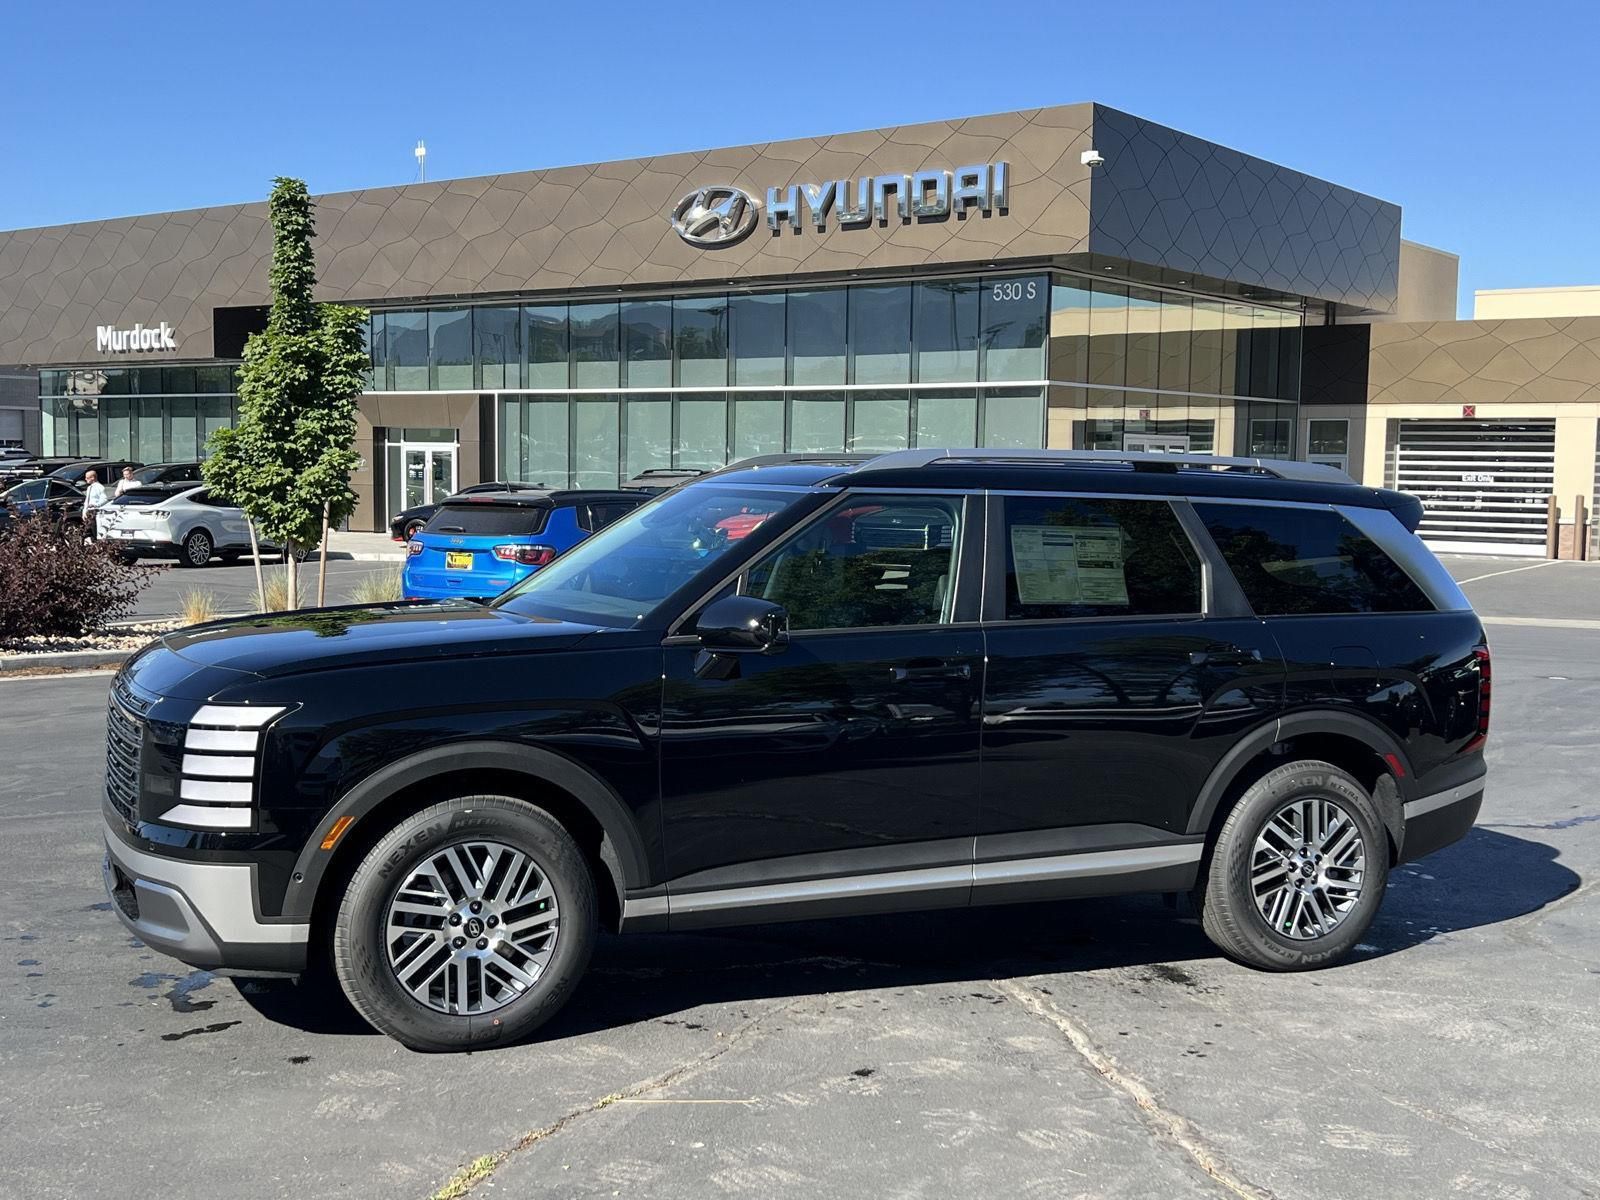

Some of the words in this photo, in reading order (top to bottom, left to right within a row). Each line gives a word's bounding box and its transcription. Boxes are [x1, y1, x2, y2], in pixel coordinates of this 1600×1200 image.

[767, 161, 1009, 233] HYUNDAI
[993, 282, 1022, 301] 530
[1026, 281, 1036, 299] S
[96, 322, 176, 352] Murdock
[377, 822, 443, 880] NEXEN
